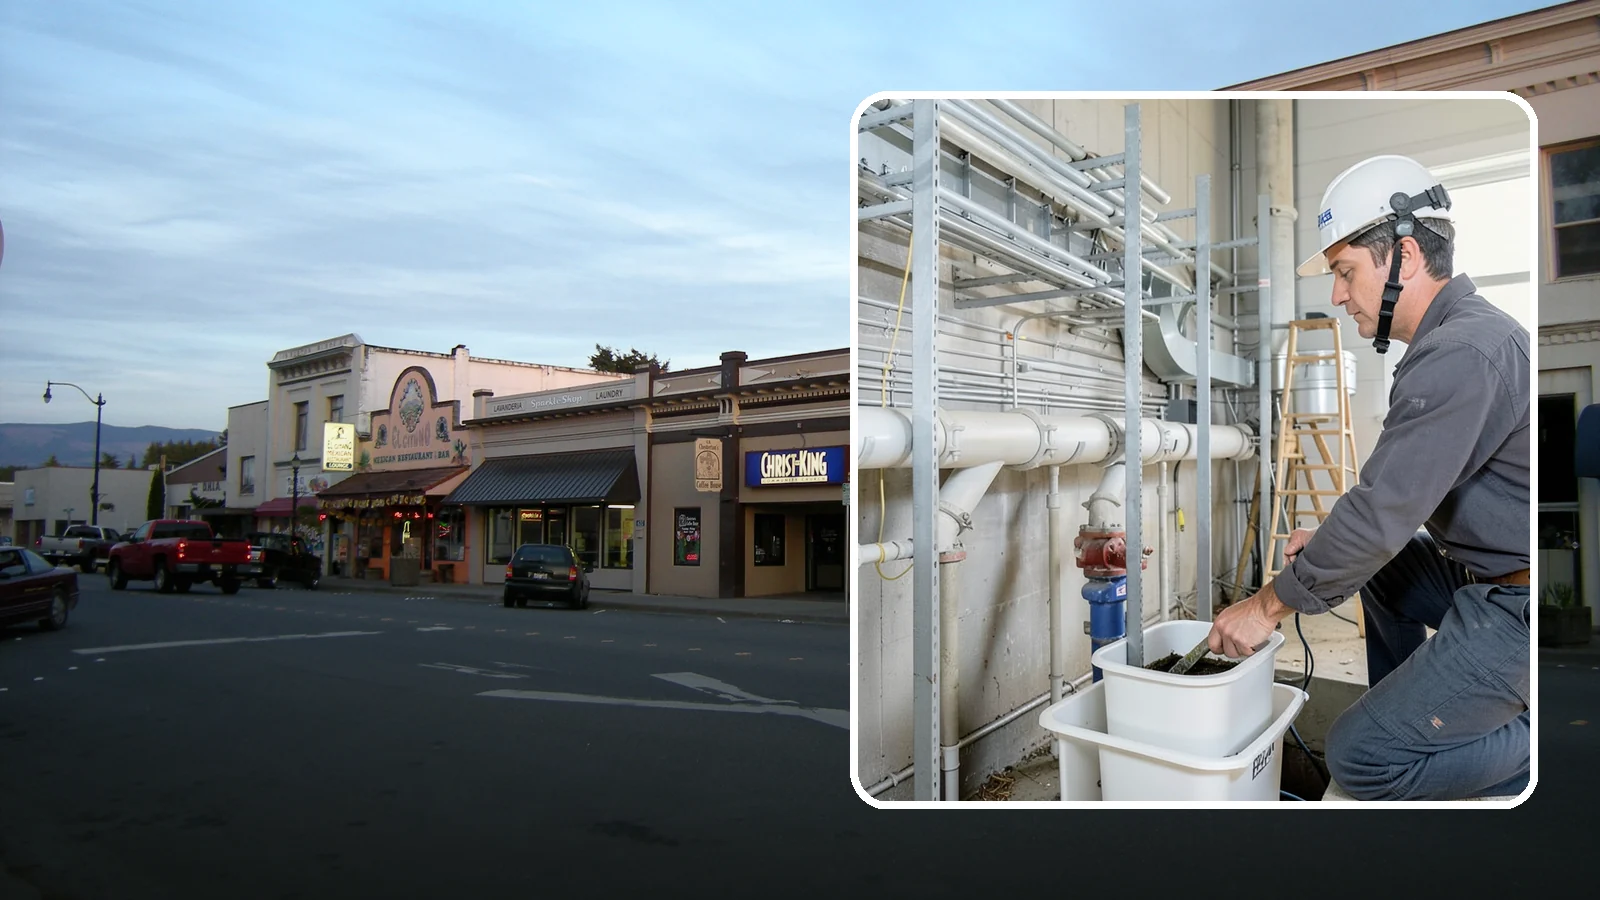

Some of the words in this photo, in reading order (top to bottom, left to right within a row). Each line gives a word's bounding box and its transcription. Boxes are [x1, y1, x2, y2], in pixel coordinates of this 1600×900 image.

[562, 394, 582, 405] Shop
[595, 388, 624, 400] LAUNDRY
[493, 402, 523, 412] LAVANDERIA
[373, 455, 397, 464] MEXICAN
[397, 451, 433, 462] RESTAURANT
[761, 452, 797, 478] CHRIST
[799, 450, 827, 477] KING
